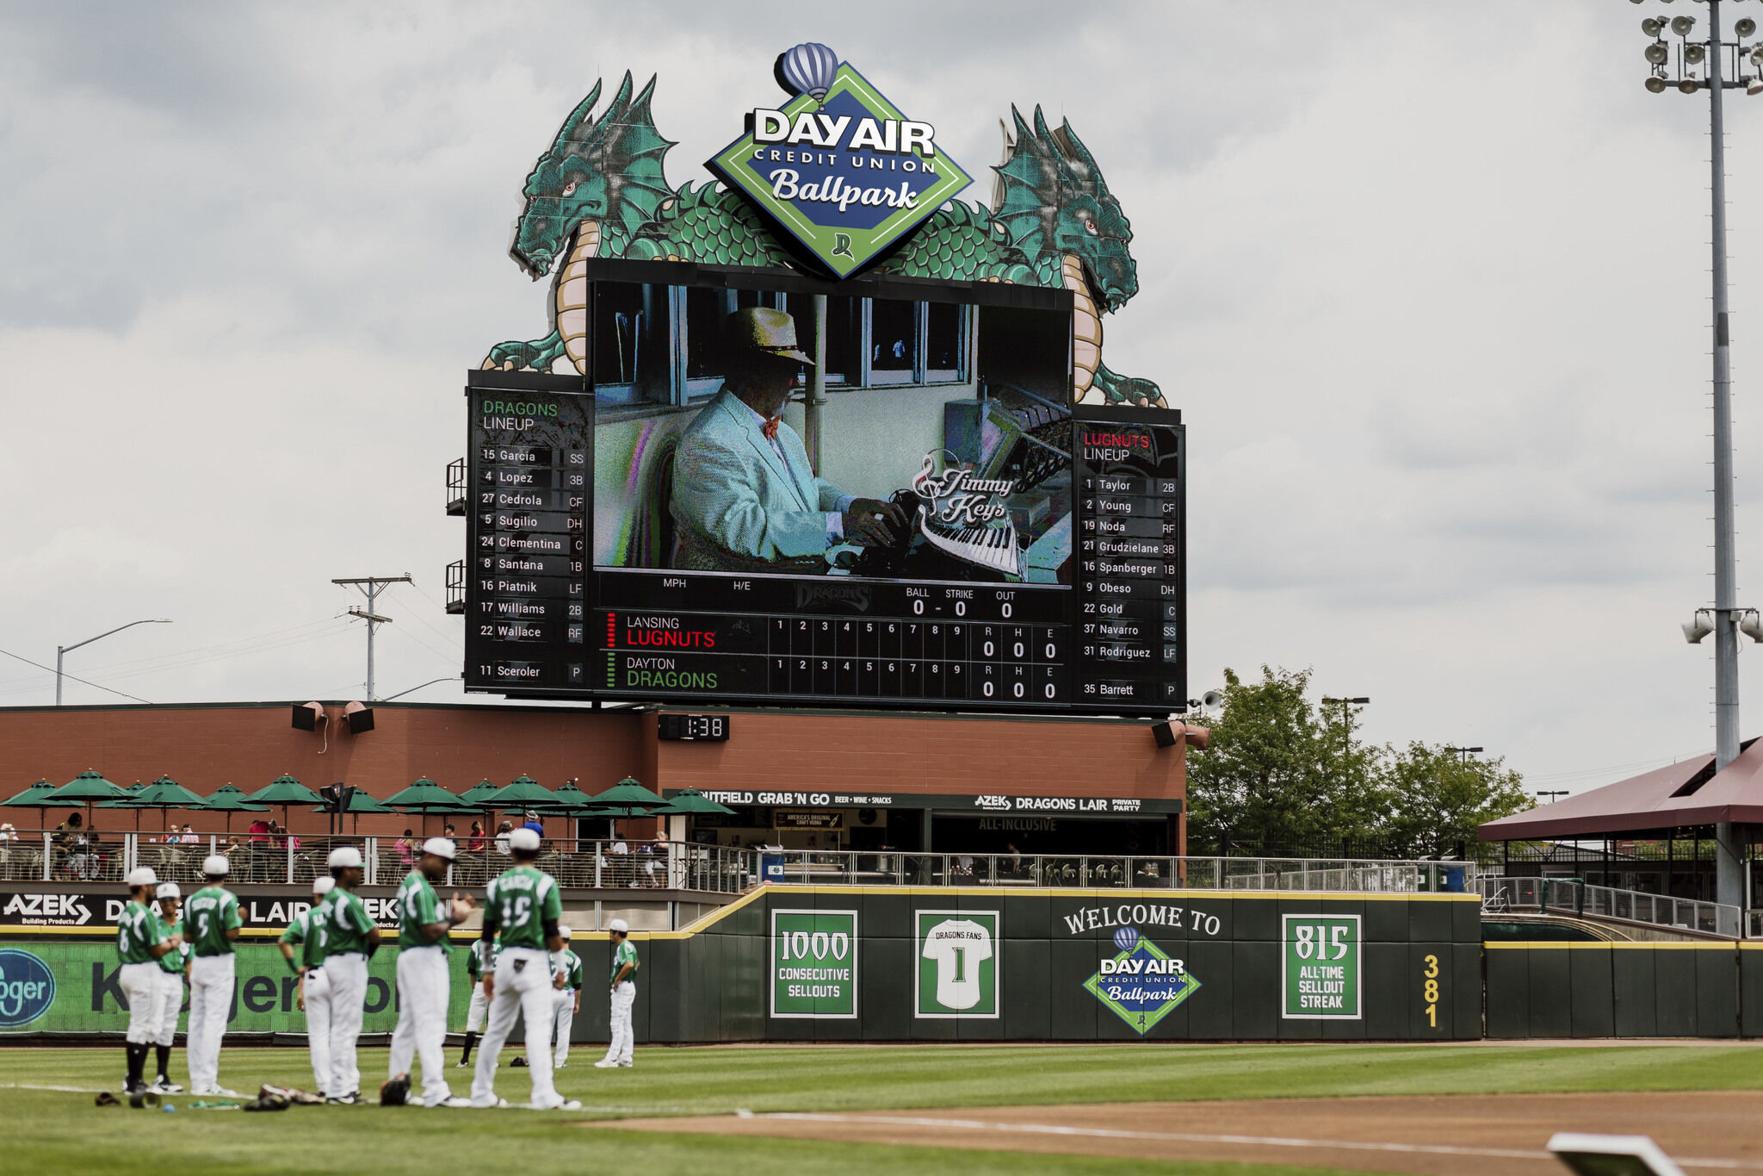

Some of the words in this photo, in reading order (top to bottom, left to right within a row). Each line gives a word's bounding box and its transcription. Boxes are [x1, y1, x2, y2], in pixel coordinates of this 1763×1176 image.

[754, 108, 852, 148] DAY
[849, 118, 936, 156] AIR
[754, 149, 837, 166] CREDIT
[852, 156, 935, 174] UNION
[769, 169, 919, 212] Ballpark
[484, 400, 558, 417] DRAGONS
[483, 417, 534, 431] LINEUP
[1084, 433, 1150, 449] LUGNUTS
[483, 450, 496, 460] 15
[500, 450, 536, 462] Garcia
[570, 454, 584, 464] SS
[1084, 448, 1130, 461] LINEUP
[485, 471, 492, 482] 4
[500, 472, 533, 484] Lopez
[570, 475, 584, 486] 3B
[938, 468, 1014, 498] Jimmy
[1086, 479, 1092, 489] 1
[1099, 480, 1131, 492] Taylor
[1162, 483, 1175, 493] 2B
[482, 493, 495, 504] 27
[499, 494, 542, 506] Cedrola
[569, 497, 584, 507] CF
[1086, 500, 1092, 510] 2
[1099, 501, 1132, 514] Young
[1162, 504, 1175, 514] CF
[942, 495, 1006, 524] Keys
[485, 514, 492, 524] 5
[499, 516, 538, 528] Sugilio
[567, 519, 582, 528] DH
[1084, 521, 1096, 530] 19
[1100, 521, 1126, 532] Noda
[1163, 524, 1175, 534] RF
[481, 536, 494, 546] 24
[499, 538, 561, 550] Clementina
[576, 541, 583, 550] C
[1084, 541, 1094, 550] 21
[1100, 542, 1159, 554] Grudzielane
[1162, 545, 1175, 554] 3B
[484, 559, 491, 568] 8
[499, 559, 544, 570] Santana
[570, 562, 582, 572] 1B
[1084, 562, 1096, 571] 16
[1100, 562, 1156, 576] Spanberger
[1163, 565, 1175, 574] 1B
[481, 581, 494, 591] 16
[499, 581, 537, 593] Piatnik
[569, 584, 582, 594] LF
[663, 579, 687, 588] MPH
[733, 581, 751, 591] H/E
[1086, 582, 1093, 592] 9
[1100, 583, 1132, 593] Obeso
[1160, 586, 1175, 595] DH
[906, 588, 930, 598] BALL
[946, 589, 974, 599] STRIKE
[996, 591, 1015, 601] OUT
[481, 602, 493, 613] 17
[498, 603, 545, 614] Williams
[568, 606, 582, 616] 2B
[913, 600, 924, 615] 0
[955, 601, 966, 616] 0
[1002, 603, 1012, 618] 0
[1084, 604, 1096, 613] 22
[1100, 604, 1123, 614] Gold
[1168, 606, 1175, 616] C
[627, 616, 680, 628] LANSING
[778, 620, 782, 629] 1
[800, 621, 806, 630] 2
[822, 621, 828, 630] 3
[843, 623, 850, 632] 4
[867, 624, 872, 632] 5
[889, 624, 894, 633] 6
[910, 625, 916, 634] 7
[932, 626, 938, 634] 8
[954, 626, 960, 635] 9
[985, 627, 992, 636] R
[1015, 628, 1022, 637] H
[1048, 629, 1053, 638] E
[481, 626, 493, 636] 22
[498, 626, 541, 637] Wallace
[568, 629, 582, 638] RF
[1084, 624, 1096, 633] 37
[1100, 625, 1138, 635] Navarro
[1163, 627, 1176, 636] SS
[627, 630, 716, 648] LUGNUTS
[984, 641, 994, 656] 0
[1014, 642, 1024, 658] 0
[1045, 643, 1056, 658] 0
[1084, 647, 1094, 656] 31
[1100, 647, 1151, 659] Rodriguez
[1164, 649, 1176, 658] LF
[627, 657, 675, 670] DAYTON
[778, 660, 782, 669] 1
[800, 660, 806, 669] 2
[822, 661, 828, 670] 3
[843, 662, 850, 670] 4
[867, 663, 872, 671] 5
[888, 663, 894, 672] 6
[910, 664, 916, 672] 7
[932, 664, 938, 674] 8
[954, 665, 960, 674] 9
[985, 666, 992, 675] R
[1015, 667, 1022, 676] H
[1047, 668, 1053, 677] E
[480, 666, 491, 676] 11
[497, 666, 540, 677] Sceroler
[573, 668, 580, 678] P
[627, 671, 718, 689] DRAGONS
[983, 681, 994, 696] 0
[1014, 682, 1024, 698] 0
[1045, 683, 1055, 698] 0
[1084, 684, 1096, 694] 35
[1100, 685, 1134, 696] Barrett
[1168, 686, 1174, 696] P
[688, 718, 722, 737] 1:38
[758, 792, 793, 804] GRAB
[794, 792, 807, 805] 'N
[810, 794, 830, 805] GO
[975, 795, 1006, 806] AZEK
[1016, 798, 1076, 810] DRAGONS
[1079, 799, 1108, 811] LAIR
[979, 816, 1056, 832] ALL-INCLUSIVE
[3, 894, 80, 916] AZEK
[22, 918, 47, 926] Building
[48, 918, 75, 926] Products
[1064, 904, 1184, 935] WELCOME
[1190, 910, 1221, 936] TO
[935, 931, 965, 940] DRAGONS
[966, 932, 982, 940] FANS
[781, 931, 849, 961] 1000
[1295, 926, 1348, 960] 815
[952, 947, 966, 983] 1
[1100, 959, 1145, 975] DAY
[1144, 959, 1184, 975] AIR
[779, 967, 850, 981] CONSECUTIVE
[1300, 966, 1344, 980] ALL-TIME
[788, 984, 840, 998] SELLOUTS
[1299, 981, 1345, 994] SELLOUT
[1107, 986, 1177, 1004] Ballpark
[1300, 995, 1343, 1009] STREAK
